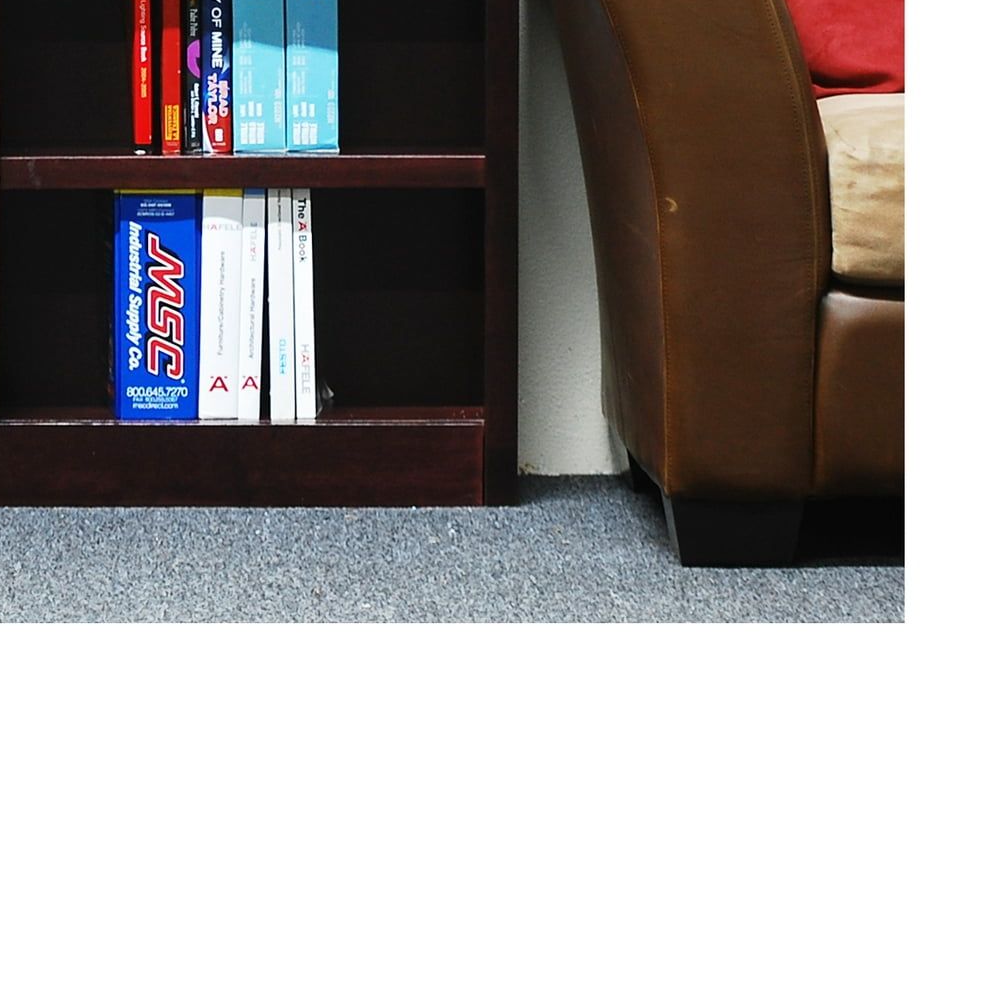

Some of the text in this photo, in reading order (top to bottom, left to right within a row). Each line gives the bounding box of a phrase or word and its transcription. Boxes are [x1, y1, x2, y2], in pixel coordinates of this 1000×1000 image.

[139, 0, 147, 24] Lighting
[211, 7, 223, 29] OF
[211, 32, 224, 68] MINE
[207, 72, 218, 125] TAYLOR
[219, 80, 230, 118] BRAD
[297, 198, 307, 220] The
[298, 235, 308, 263] Book
[126, 221, 143, 371] Industrial Supply Co.
[147, 232, 186, 382] MSC
[216, 251, 226, 356] Furniture/Cabinetry Hardware
[247, 277, 257, 359] Architectural Hardware
[126, 386, 188, 398] 800.645.7270
